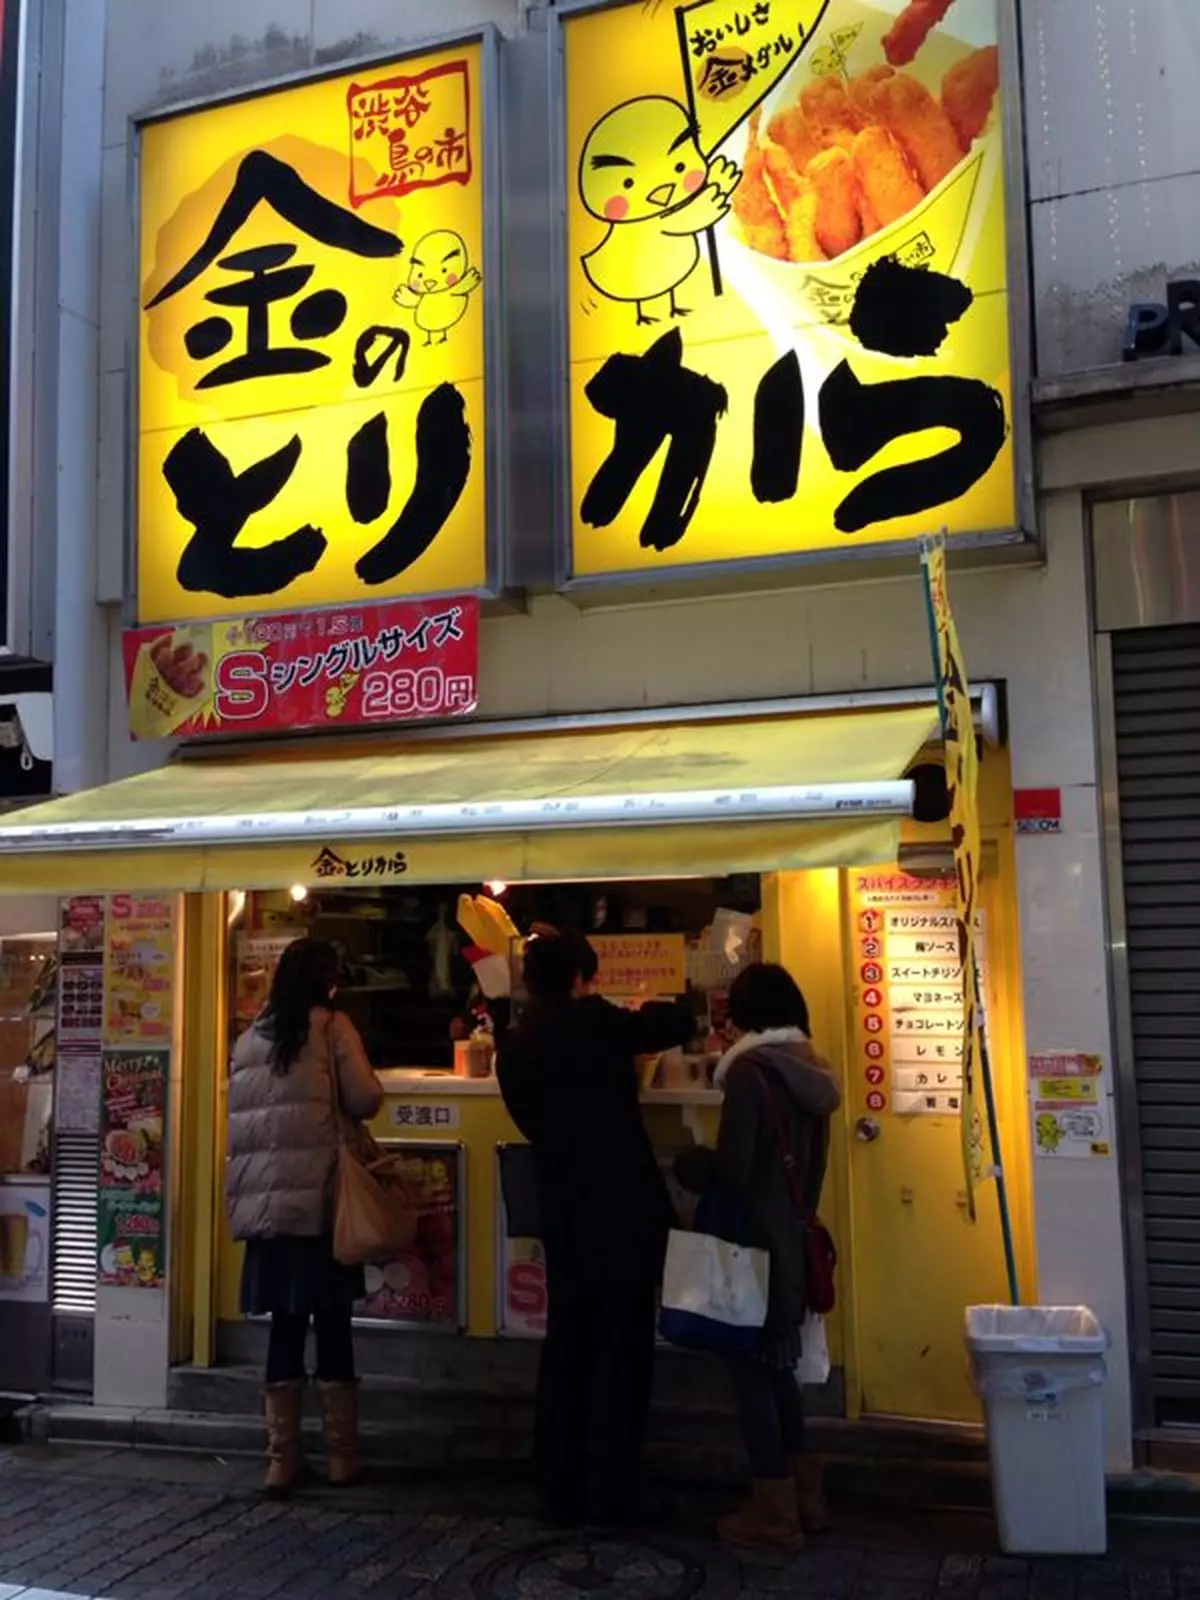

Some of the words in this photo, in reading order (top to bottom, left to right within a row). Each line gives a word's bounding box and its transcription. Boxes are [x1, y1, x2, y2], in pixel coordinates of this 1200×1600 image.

[690, 2, 770, 57] おいしさ
[353, 84, 431, 140] 渋谷
[144, 150, 410, 390] 金の
[580, 256, 1010, 551] から
[163, 382, 472, 598] とり
[214, 651, 269, 720] S
[270, 607, 463, 695] シングルサイズ
[361, 666, 474, 718] 280円
[310, 847, 408, 878] 金のとりから
[396, 1105, 451, 1126] 受渡口
